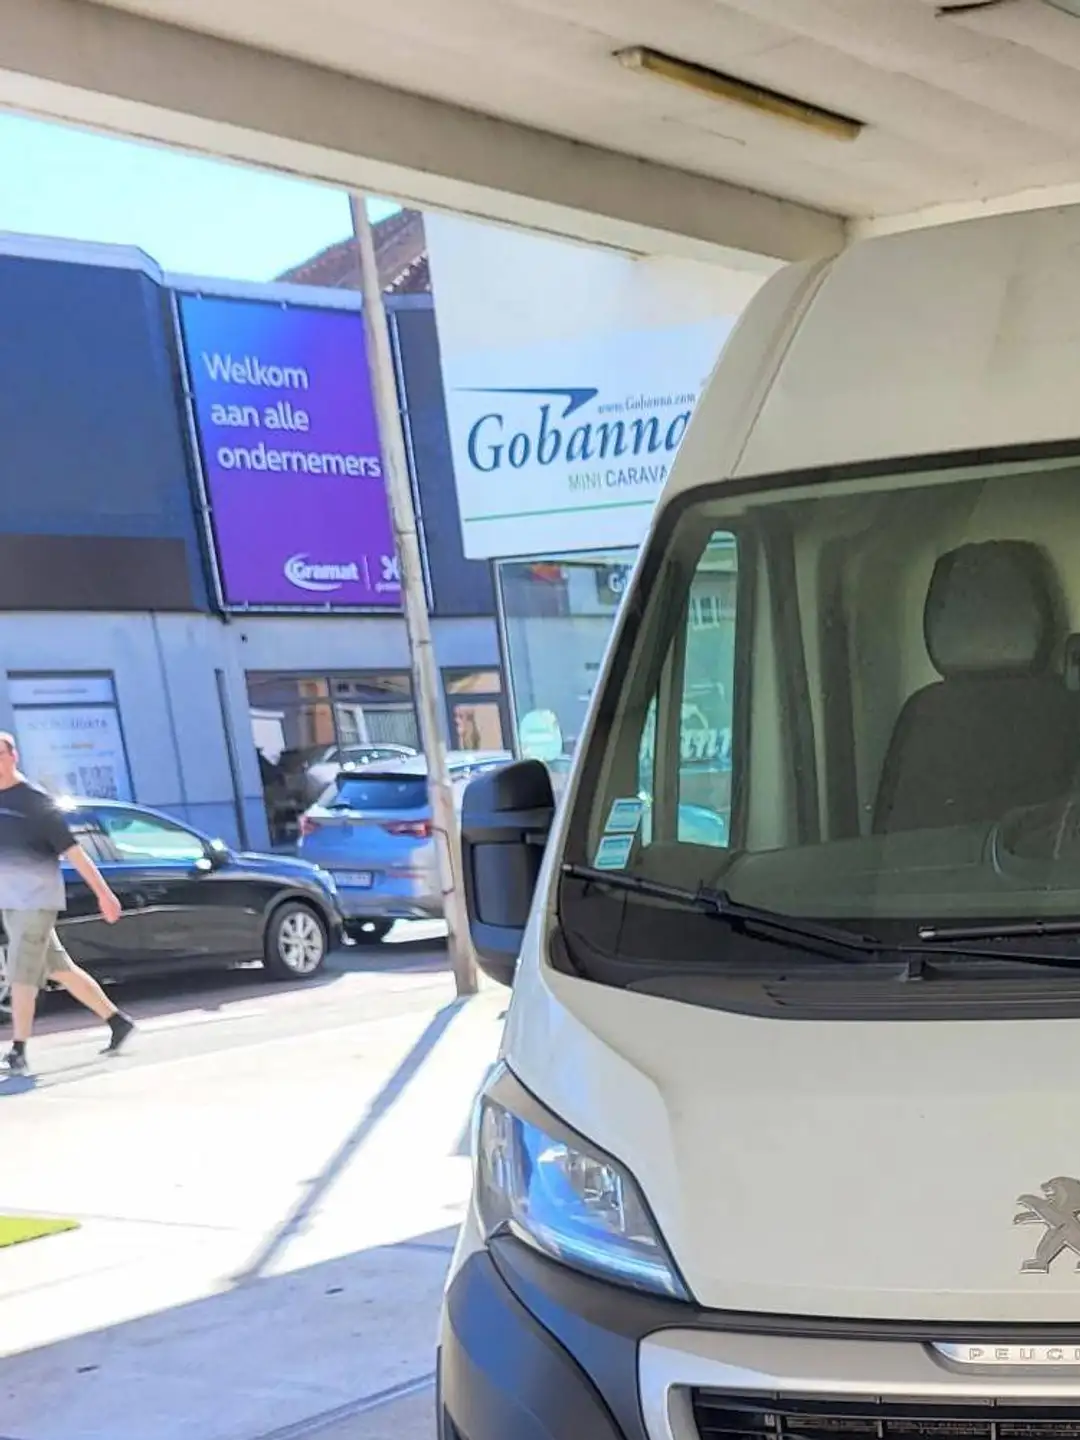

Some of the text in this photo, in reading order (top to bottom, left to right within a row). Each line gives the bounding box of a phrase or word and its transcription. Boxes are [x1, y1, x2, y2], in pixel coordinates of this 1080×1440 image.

[203, 352, 309, 389] Welkom
[211, 401, 309, 431] aan alle
[467, 403, 692, 473] Gobanna
[217, 441, 382, 478] ondernemers
[568, 473, 600, 491] MINI
